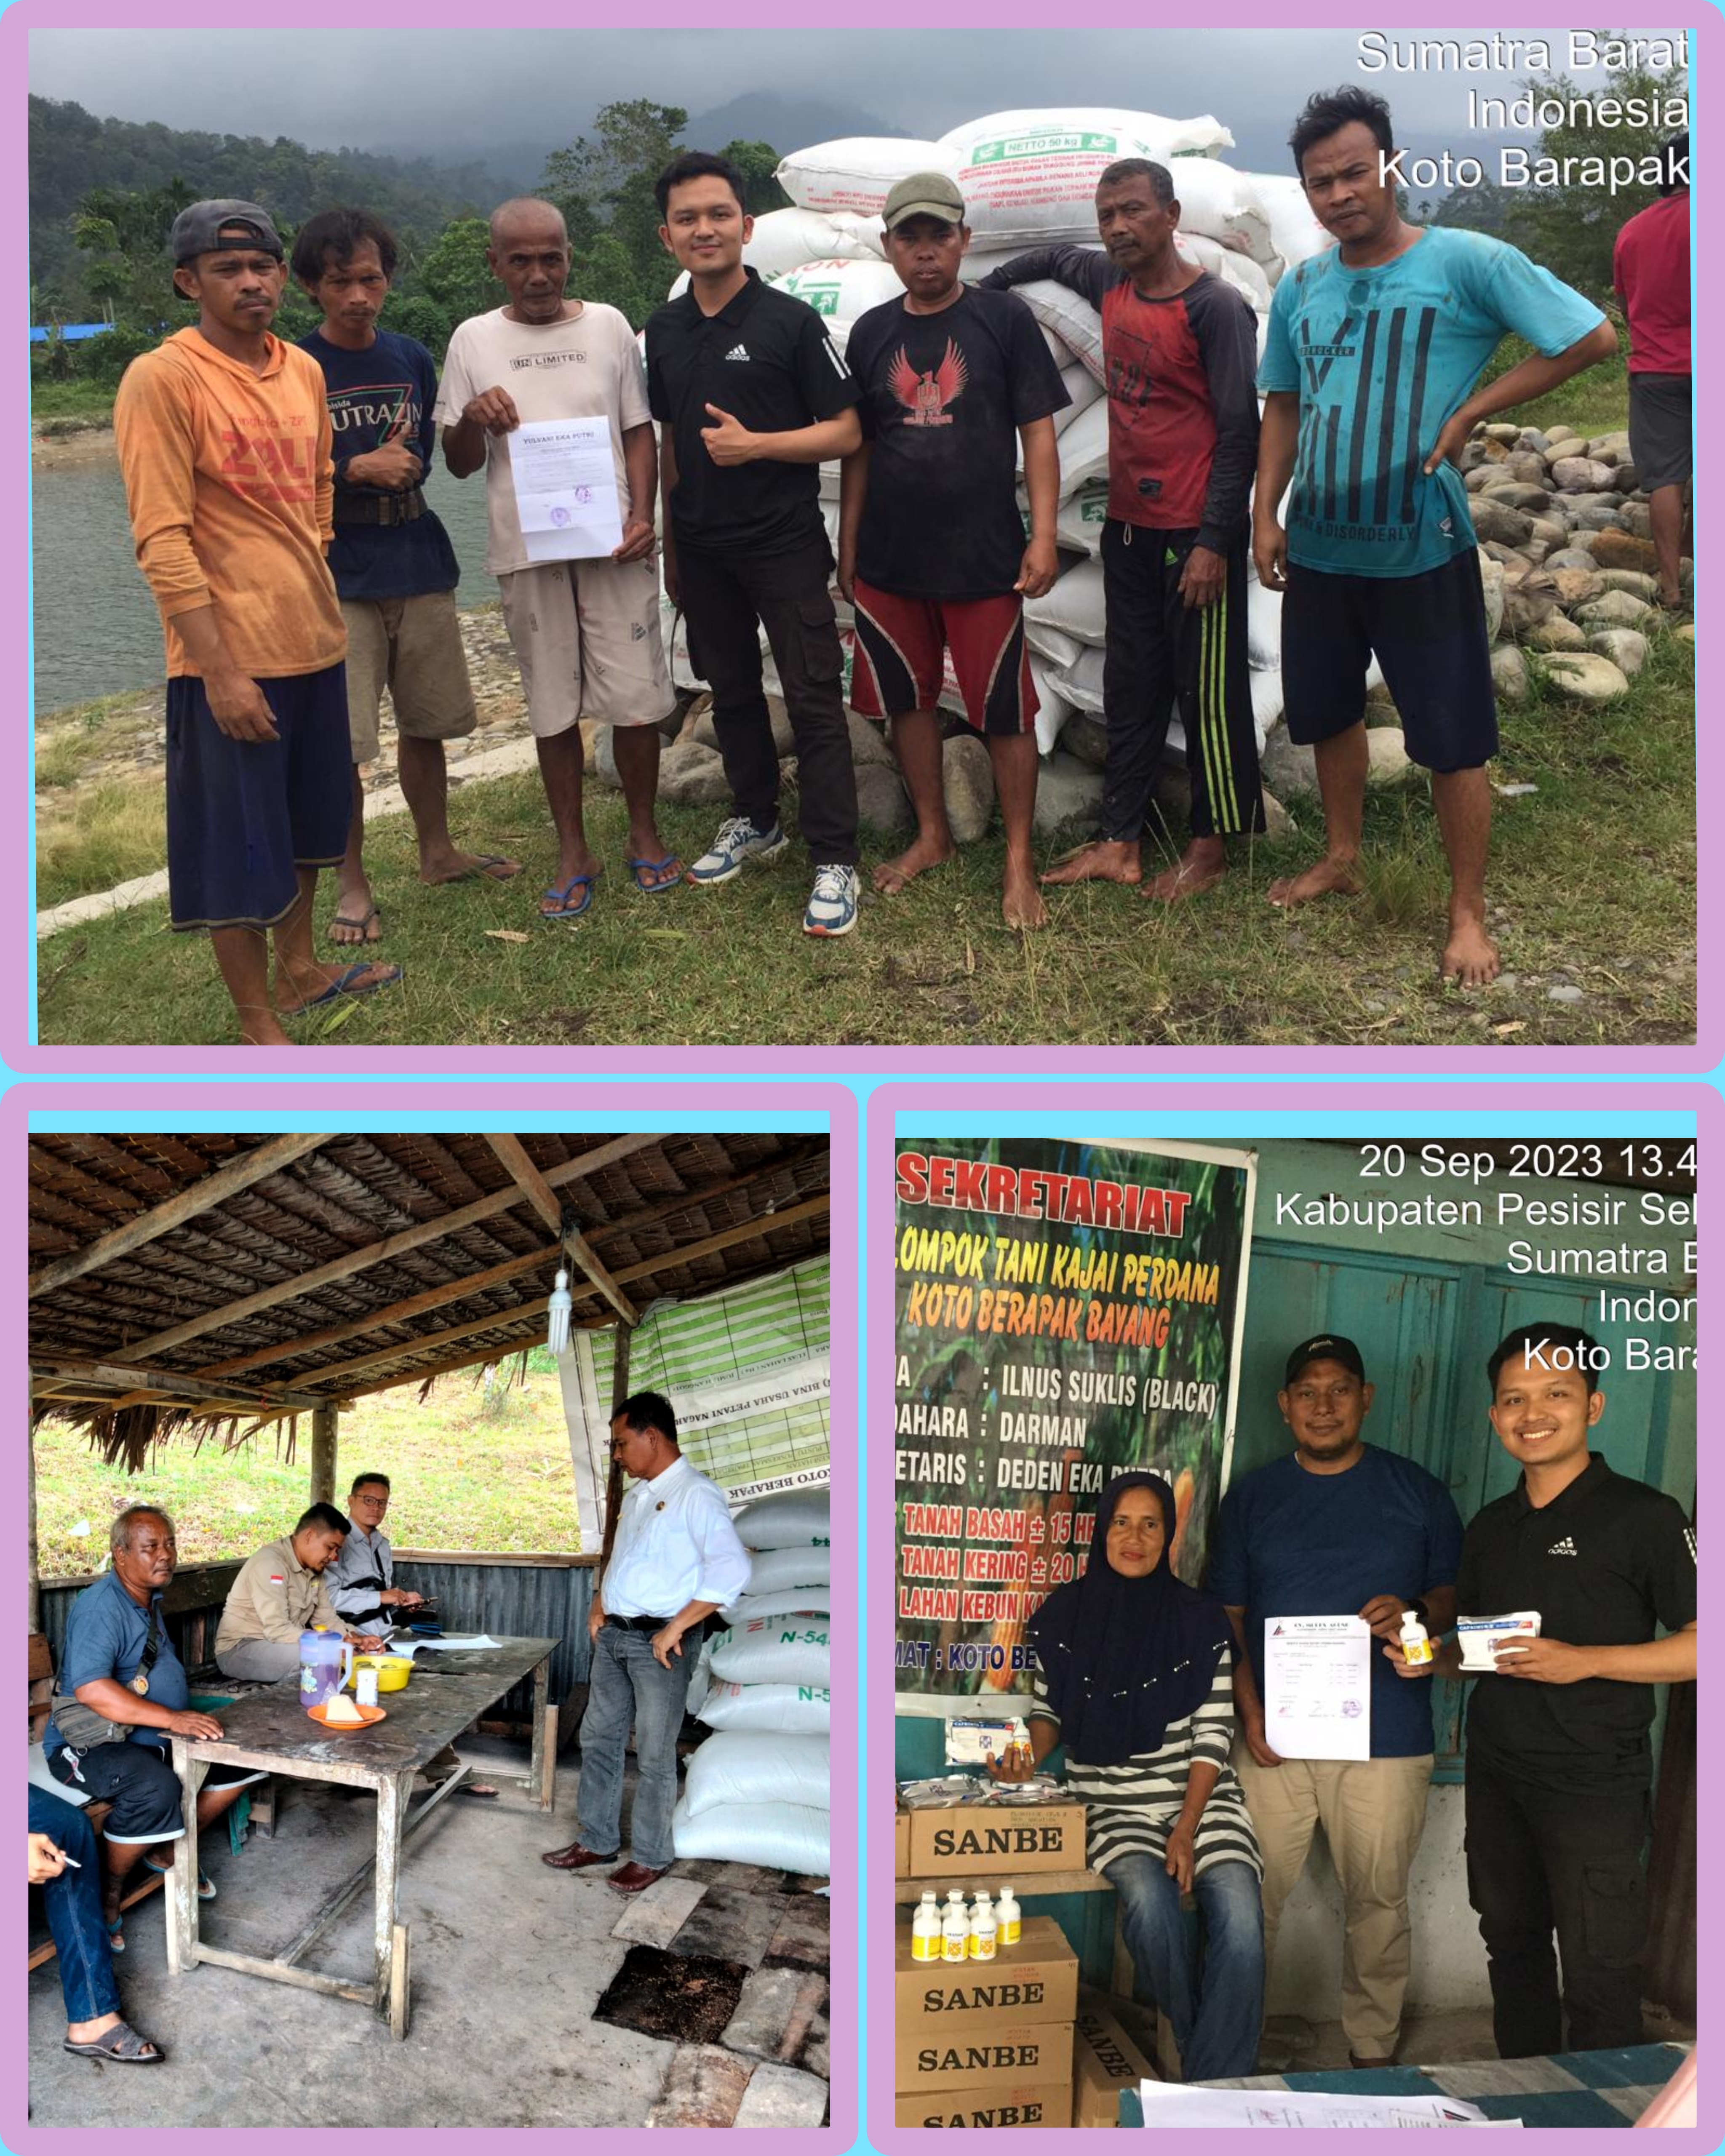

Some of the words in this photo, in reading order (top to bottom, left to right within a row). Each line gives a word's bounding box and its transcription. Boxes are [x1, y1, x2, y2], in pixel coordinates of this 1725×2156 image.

[1008, 141, 1046, 152] NETTO
[1049, 138, 1060, 147] 50
[535, 353, 585, 366] LIMITED
[896, 1152, 1191, 1238] SEKRETARIAT
[995, 1236, 1049, 1285] TANI
[1051, 1243, 1119, 1294] KAJAI
[1122, 1257, 1220, 1305] PERDANA
[908, 1281, 973, 1329] KOTO
[977, 1289, 1084, 1343] BERAPAK
[1086, 1300, 1171, 1350] BAYANG
[753, 1391, 788, 1406] USAHA
[792, 1382, 820, 1395] BINA
[1002, 1364, 1062, 1400] ILNUS
[1068, 1370, 1137, 1406] SUKLIS
[1142, 1377, 1219, 1421] (BLACK)
[711, 1401, 750, 1418] PETANI
[999, 1412, 1087, 1447] DARMAN
[895, 1450, 967, 1485] ETARIS
[997, 1458, 1063, 1492] DEDEN
[1068, 1462, 1103, 1494] EKA
[728, 1476, 793, 1500] BERAPAK
[903, 1502, 963, 1538] TANAH
[966, 1507, 1026, 1542] BASAH
[1050, 1512, 1072, 1544] 15
[901, 1544, 960, 1580] TANAH
[963, 1548, 1028, 1582] KERING
[1050, 1551, 1073, 1584] 20
[899, 1585, 959, 1622] LAHAN
[961, 1590, 1020, 1622] KEBUN
[948, 1643, 1006, 1671] KOTO
[934, 1827, 1063, 1856] SANBE
[924, 1983, 1044, 2013] SANBE
[918, 2044, 1039, 2072] SANBE
